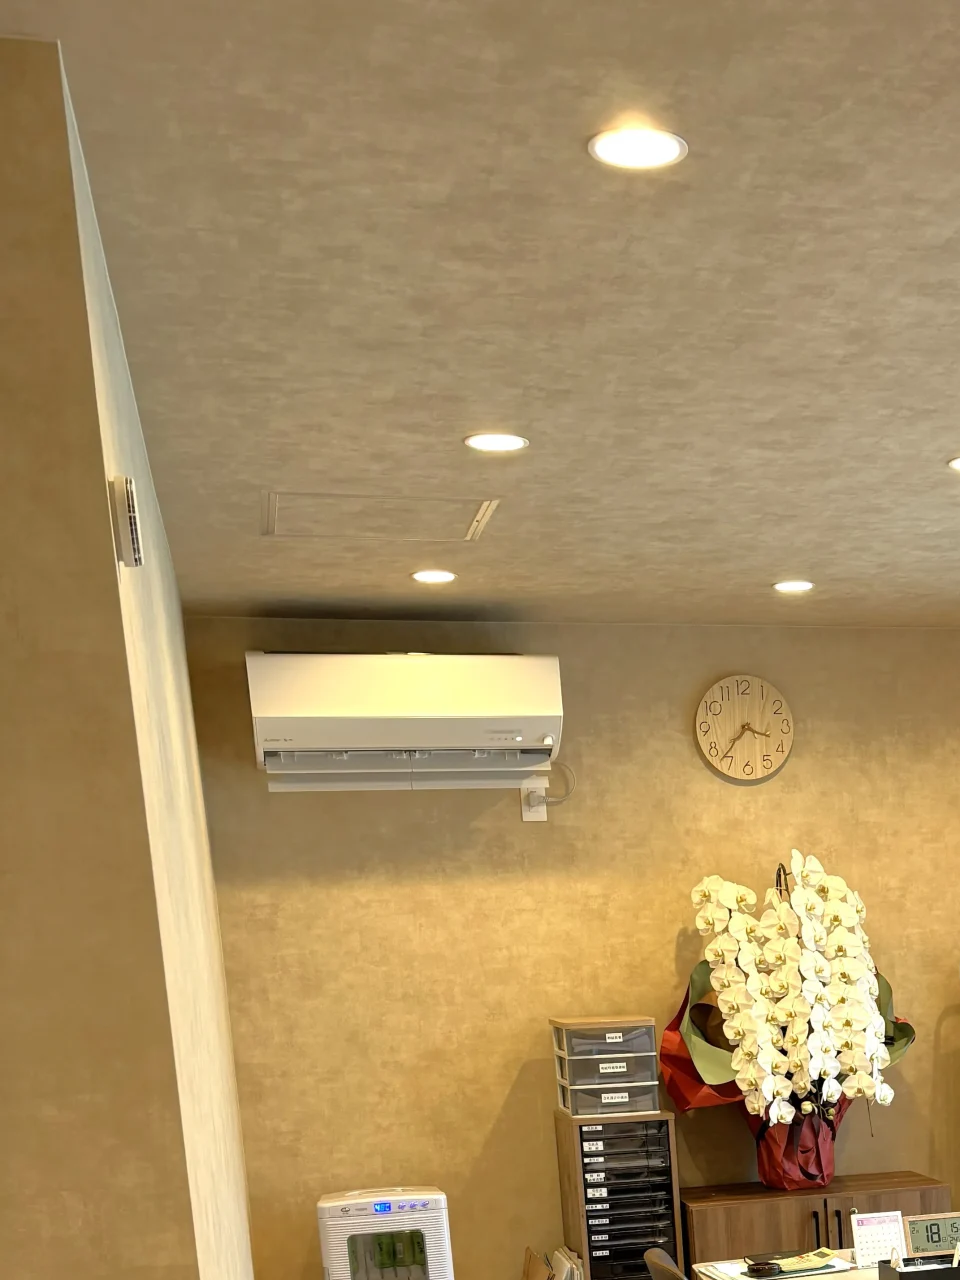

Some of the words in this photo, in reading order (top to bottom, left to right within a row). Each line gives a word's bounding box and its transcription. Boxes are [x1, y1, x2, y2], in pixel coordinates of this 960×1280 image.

[720, 685, 730, 701] 11
[735, 679, 751, 696] 12
[704, 700, 722, 716] 10
[772, 699, 783, 715] 2
[699, 721, 710, 737] 9
[780, 718, 791, 734] 3
[708, 741, 719, 757] 8
[775, 739, 785, 754] 4
[724, 755, 734, 771] 7
[742, 760, 754, 776] 6
[762, 754, 773, 769] 5
